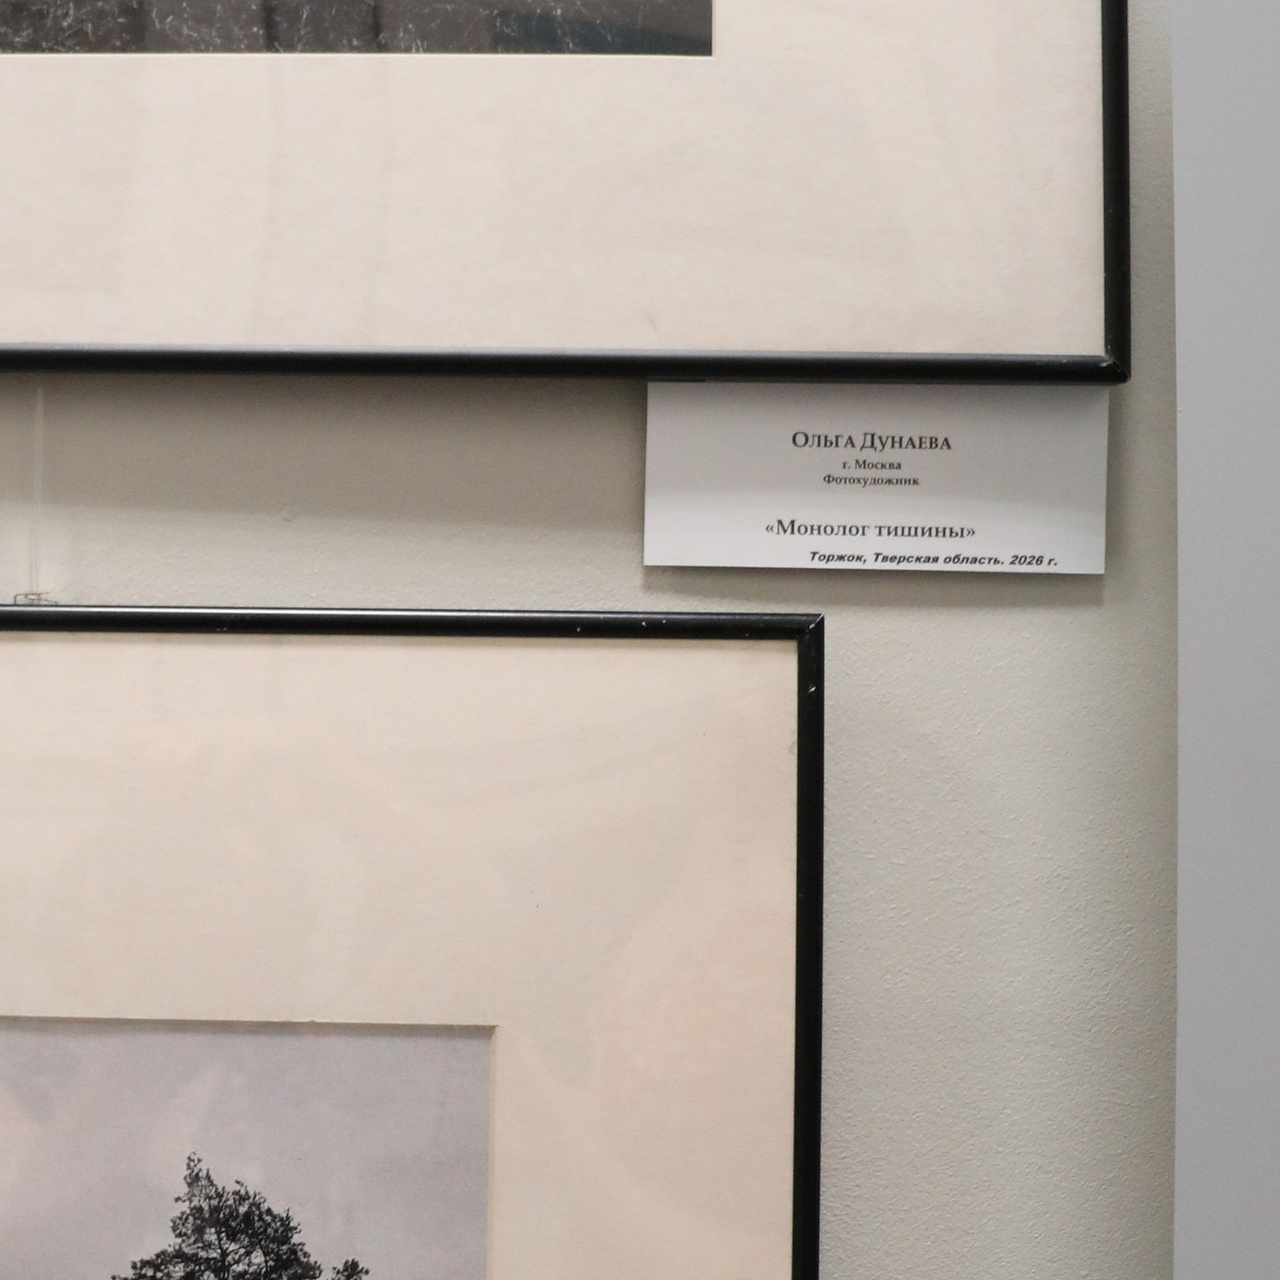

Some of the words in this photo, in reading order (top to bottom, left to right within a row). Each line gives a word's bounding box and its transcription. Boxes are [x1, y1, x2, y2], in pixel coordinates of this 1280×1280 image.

[841, 460, 851, 470] г.
[854, 459, 902, 471] Москва
[822, 473, 920, 488] Фотохудожник
[764, 518, 871, 537] «Монолог
[873, 524, 977, 539] тишины»
[809, 550, 868, 565] Торжок,
[872, 551, 941, 566] Тверская
[942, 553, 1005, 566] область.
[1008, 554, 1045, 567] 2026
[1046, 557, 1058, 567] г.
